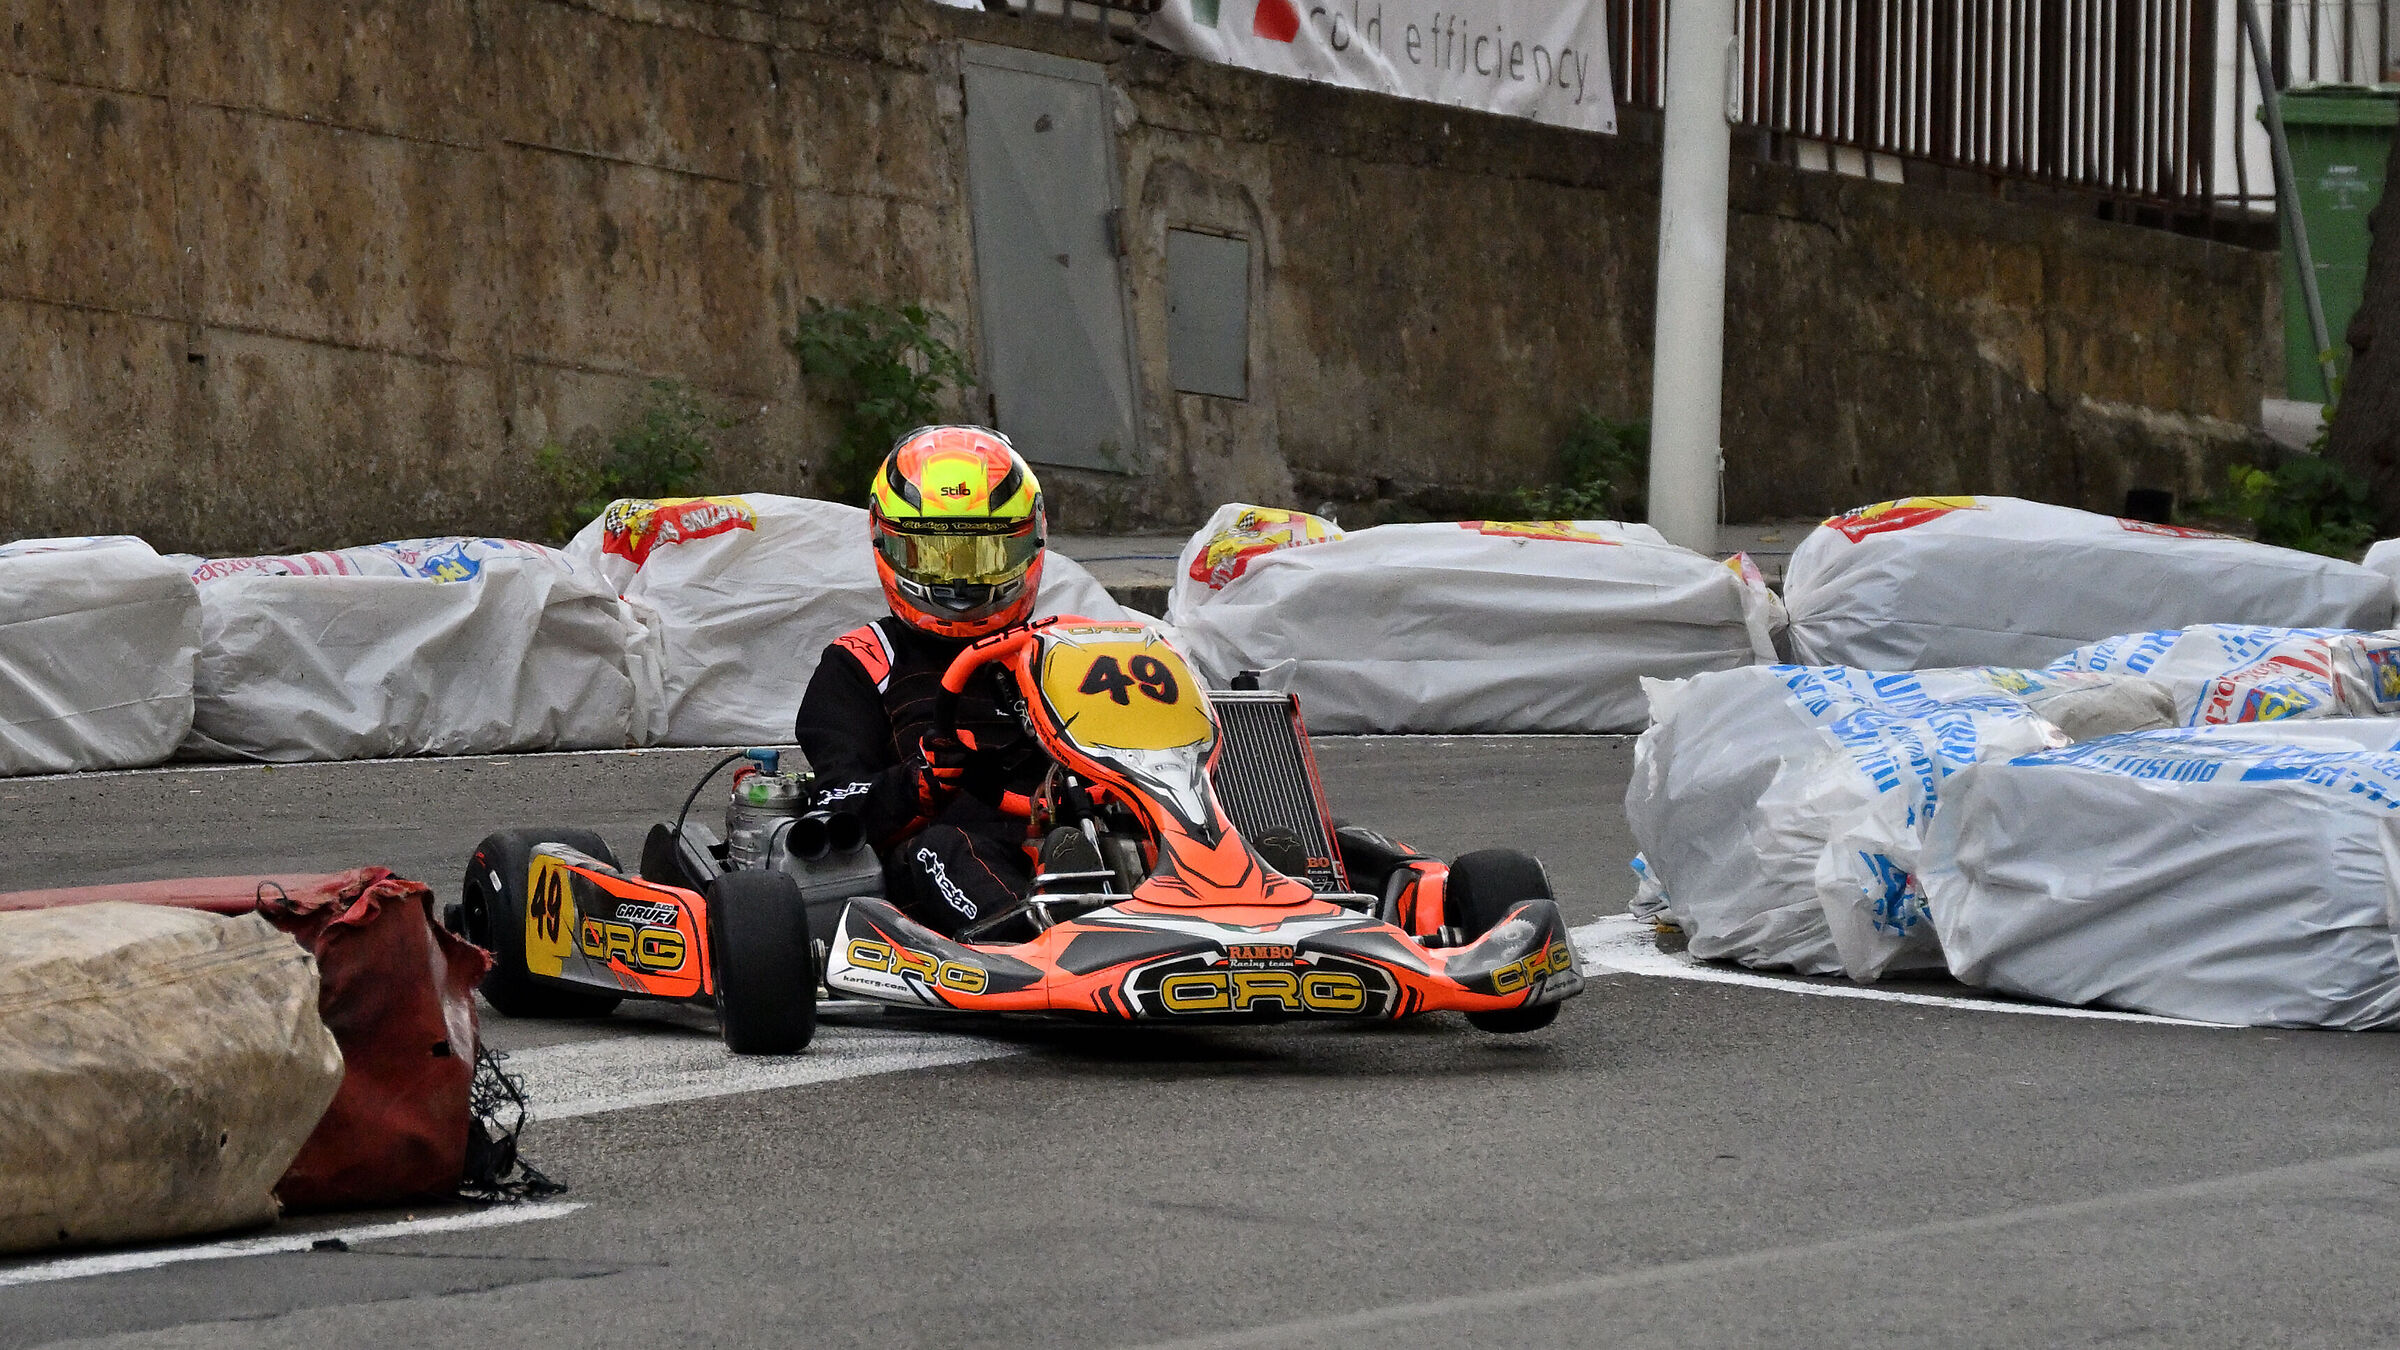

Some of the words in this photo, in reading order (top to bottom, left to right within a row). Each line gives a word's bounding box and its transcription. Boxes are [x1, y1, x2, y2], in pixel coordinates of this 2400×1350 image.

[1310, 2, 1381, 53] cold
[1406, 12, 1588, 105] efficiency
[941, 482, 970, 497] Stilo
[1078, 655, 1179, 706] 49
[531, 864, 562, 944] 49
[616, 903, 679, 925] GARUFI
[582, 917, 687, 972] CRG
[847, 938, 989, 995] CRG
[1228, 946, 1294, 959] RAMBO
[1230, 960, 1264, 969] Racing
[1269, 960, 1294, 968] team
[843, 975, 908, 992] kartcrg.com
[1160, 970, 1367, 1014] CRG
[1490, 940, 1572, 997] CRG
